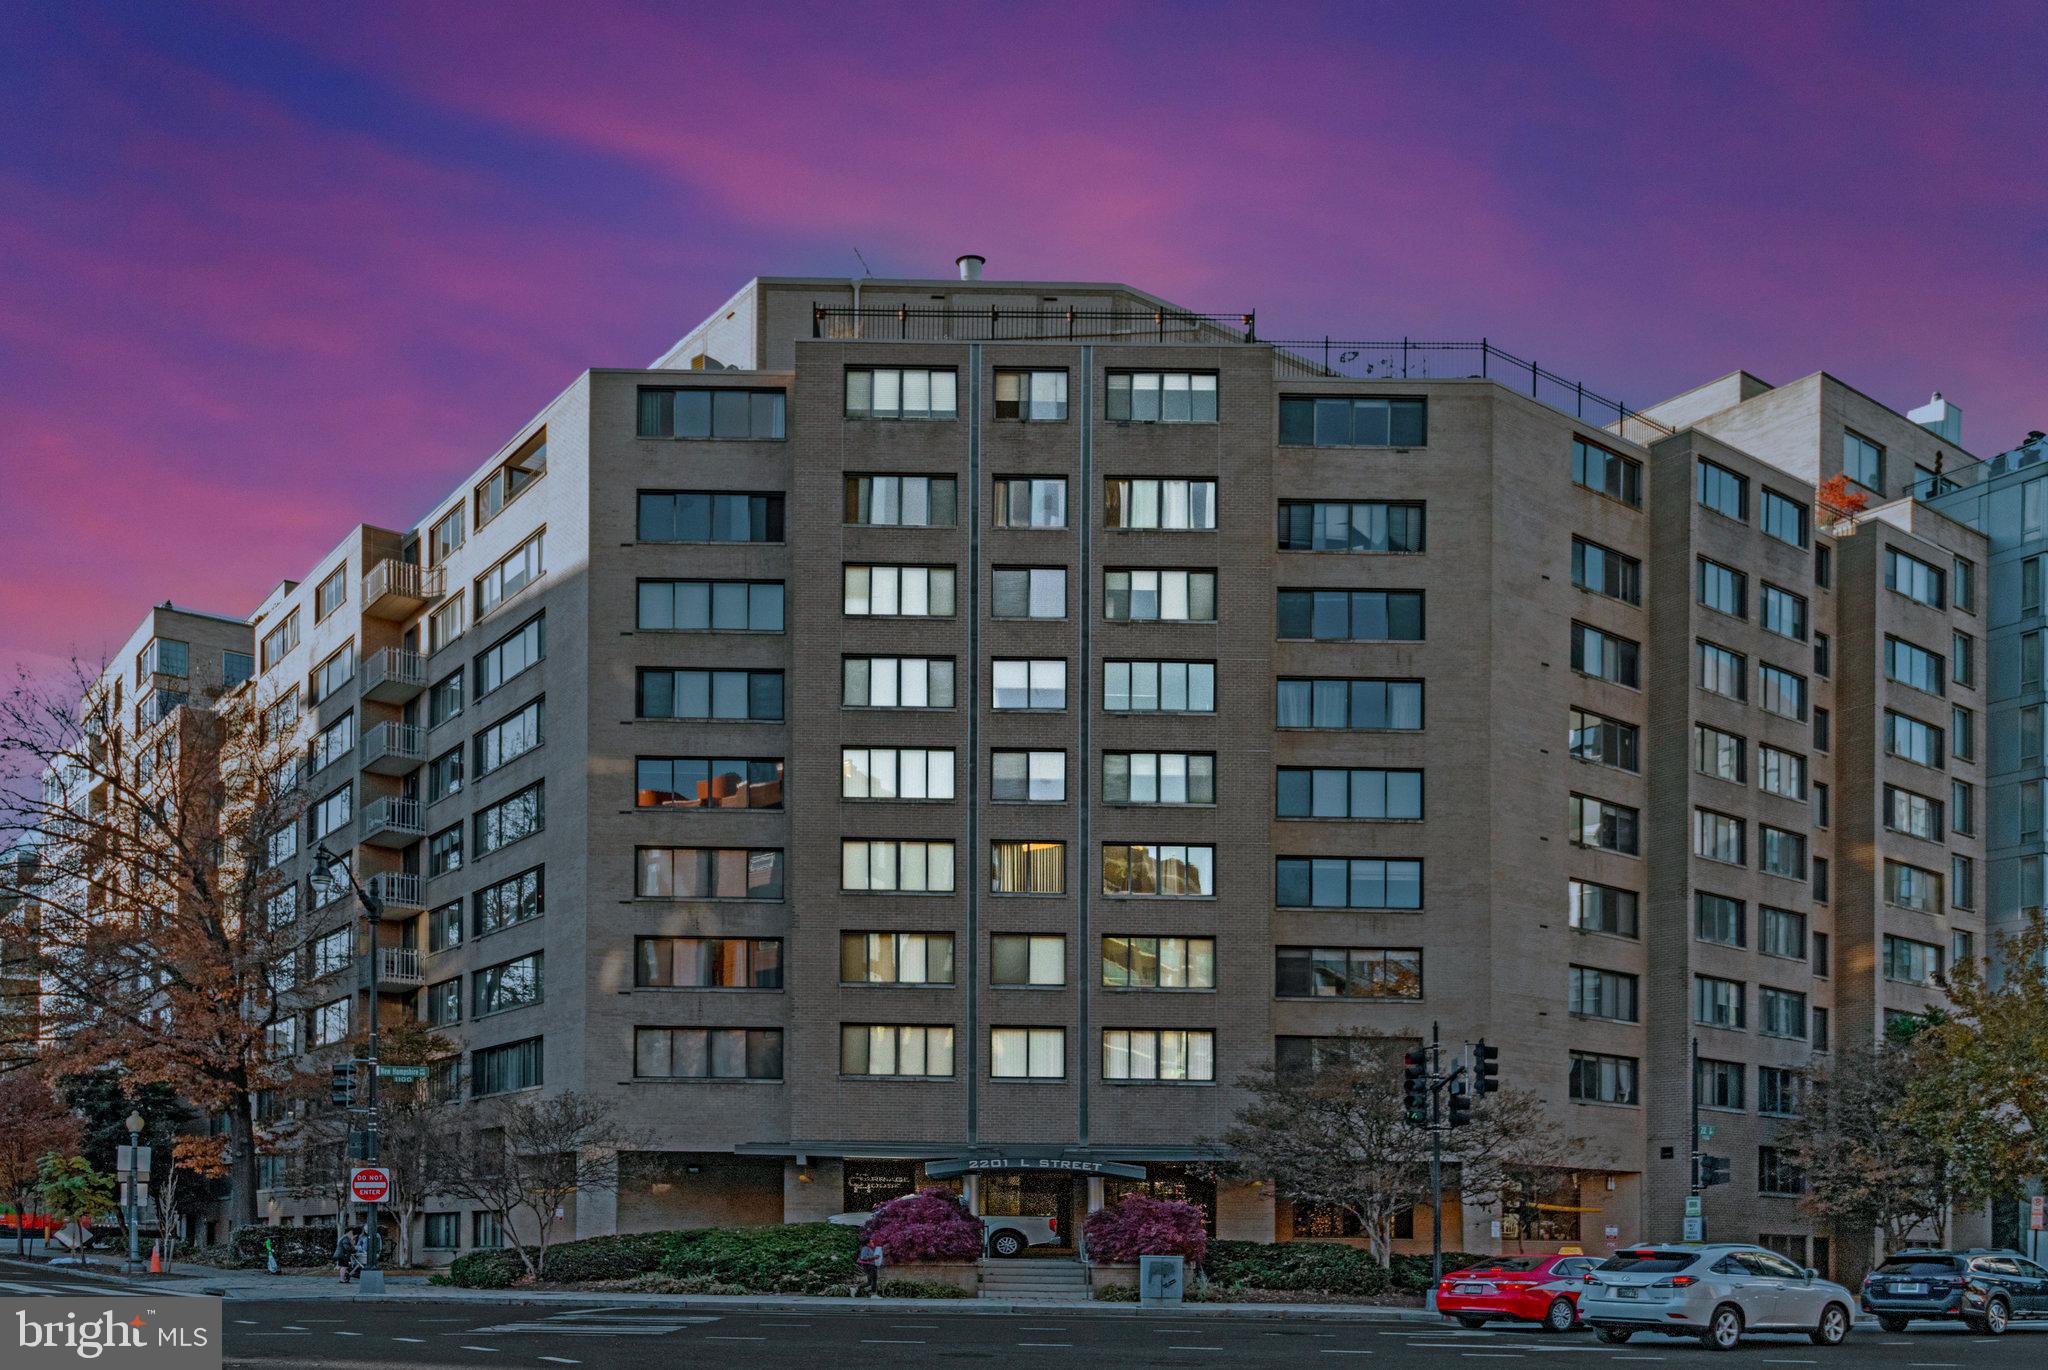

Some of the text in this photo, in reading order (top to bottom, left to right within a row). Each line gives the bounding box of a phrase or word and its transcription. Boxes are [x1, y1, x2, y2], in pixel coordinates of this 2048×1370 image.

[393, 1067, 418, 1076] Hampshire
[969, 1159, 1102, 1171] 2201 L STREET
